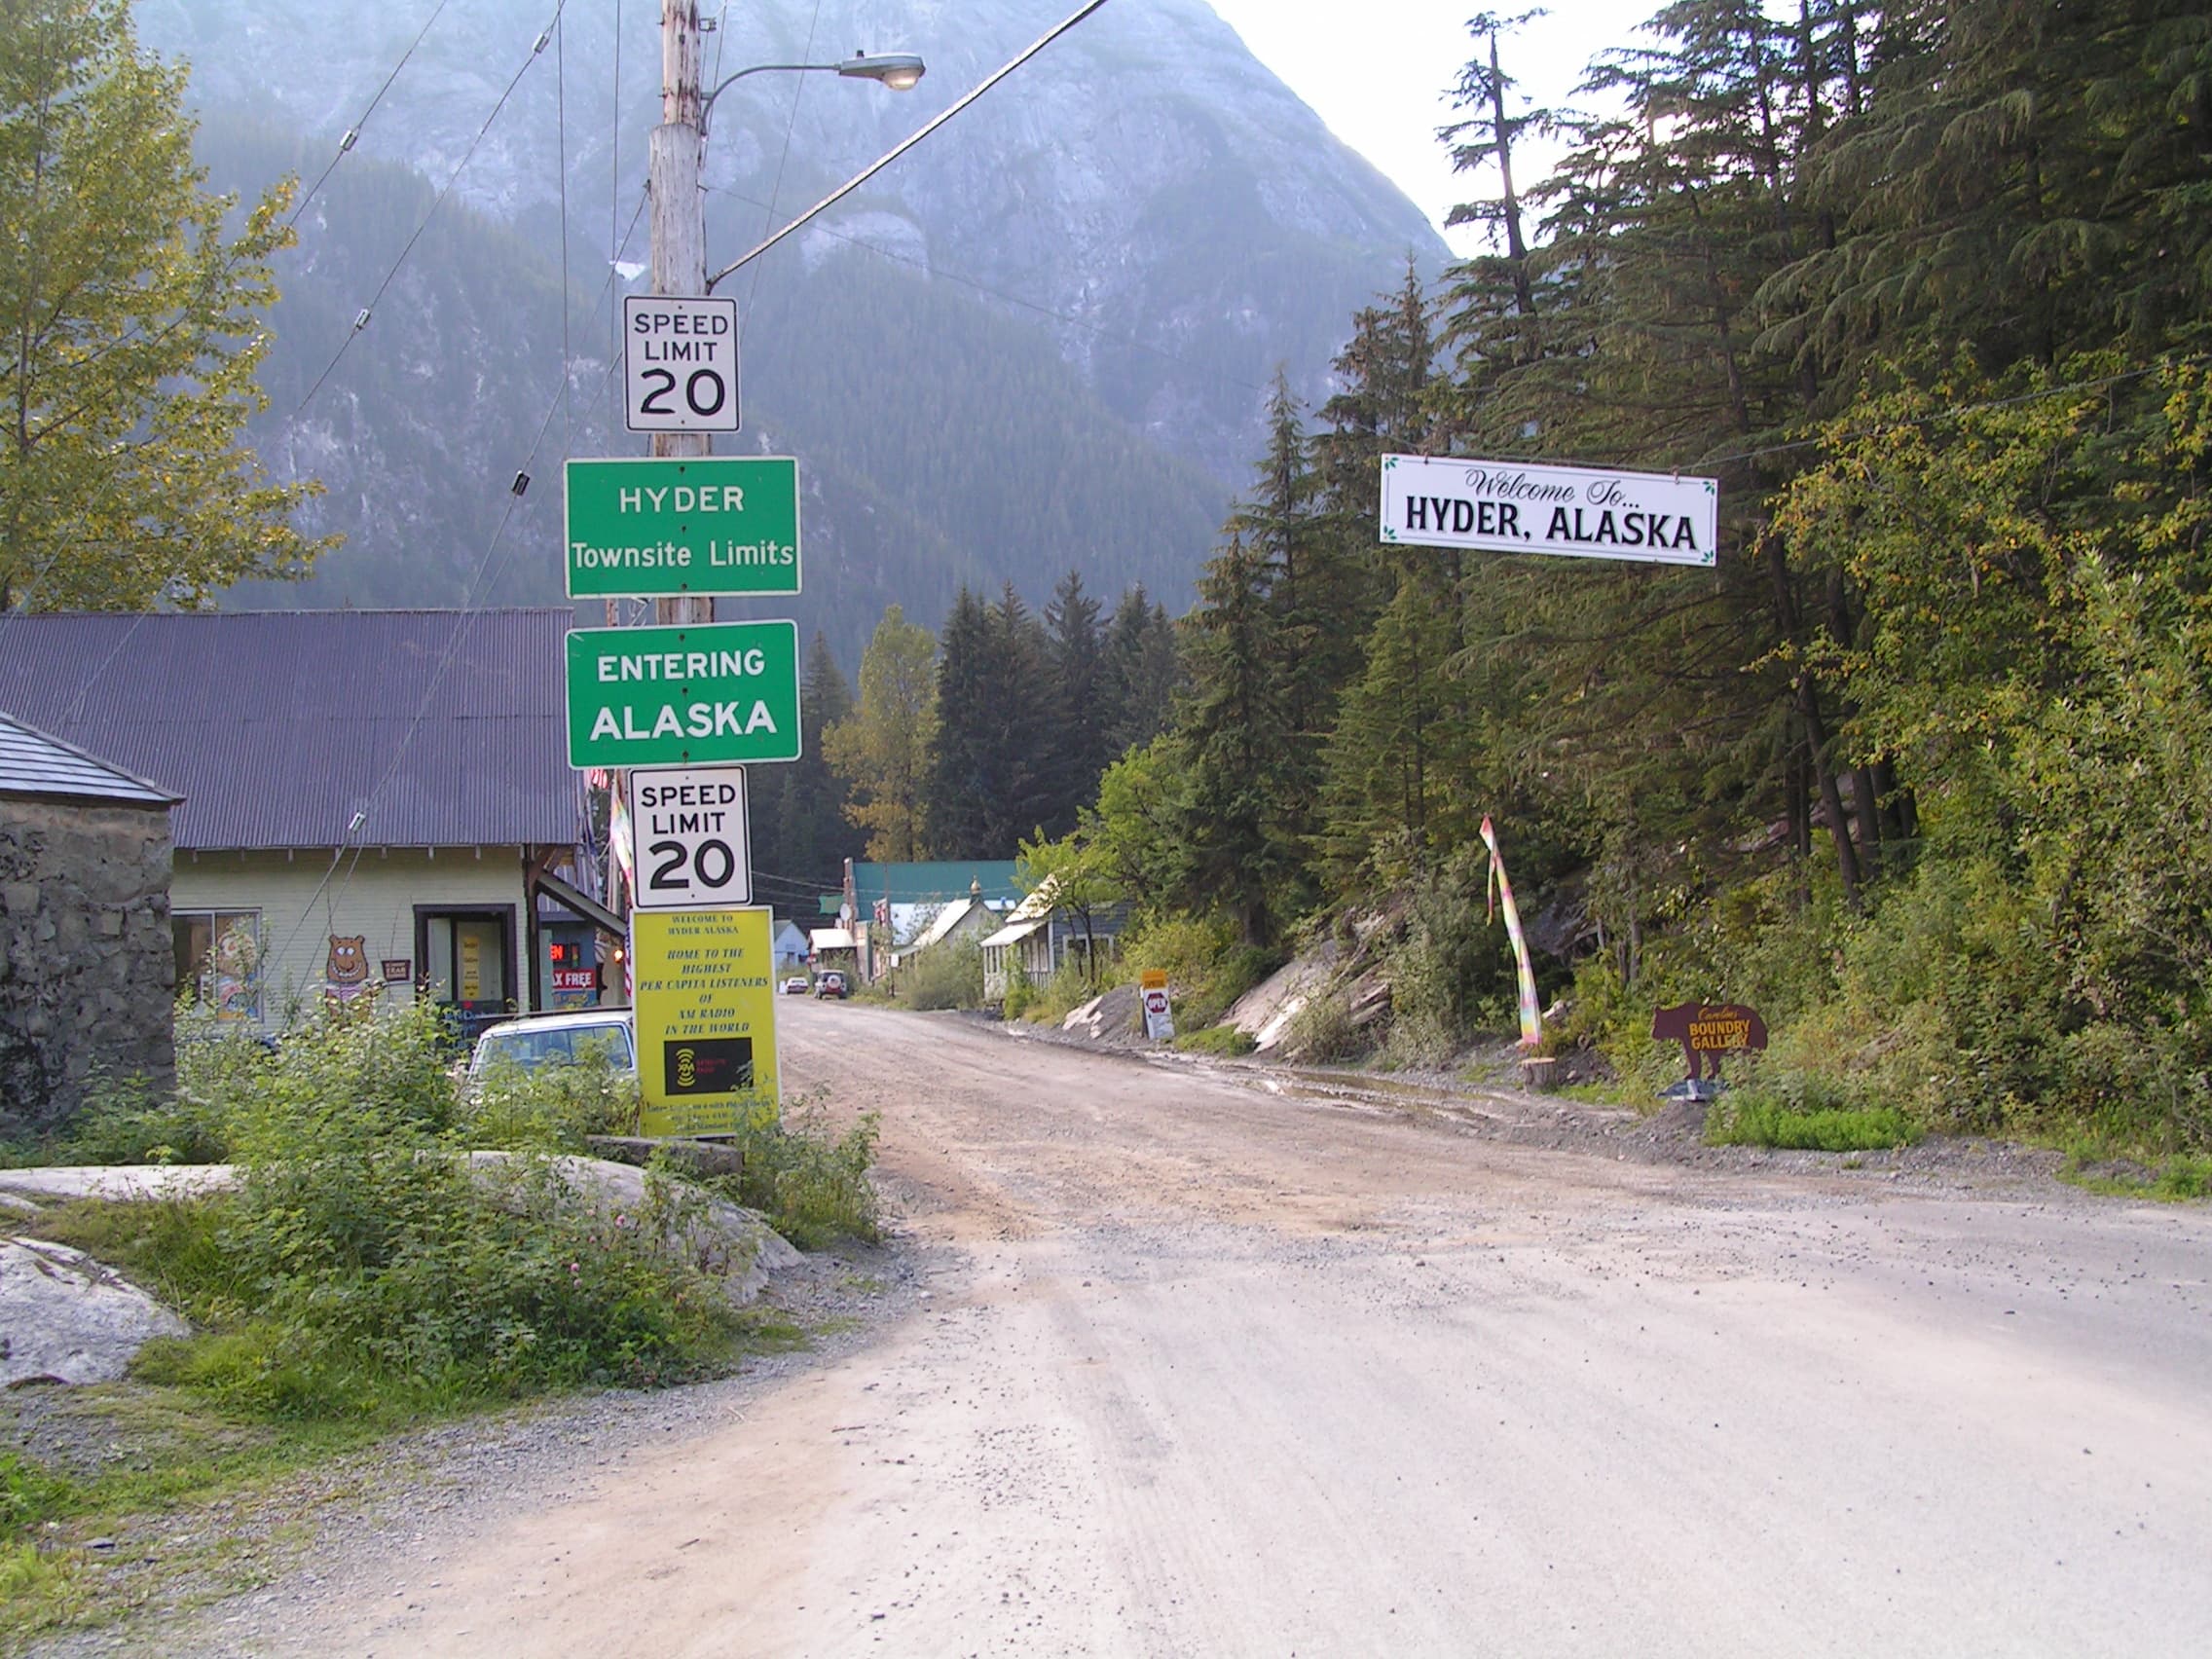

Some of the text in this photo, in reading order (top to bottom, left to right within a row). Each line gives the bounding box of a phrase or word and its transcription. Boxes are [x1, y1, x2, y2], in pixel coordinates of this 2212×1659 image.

[634, 313, 728, 335] SPEED
[645, 341, 718, 361] LIMIT
[641, 368, 725, 416] 20
[1464, 468, 1575, 501] Welcome
[619, 486, 744, 513] HYDER
[1406, 496, 1699, 551] HYDER, ALASKA
[571, 540, 794, 568] Townsite Limits
[598, 648, 765, 682] ENTERING
[589, 700, 777, 741] ALASKA
[642, 784, 736, 807] SPEED
[652, 812, 725, 834] LIMIT
[648, 839, 735, 890] 20
[705, 926, 739, 935] ALASKA
[667, 948, 744, 959] HOME TO THE
[566, 973, 592, 986] FREE
[682, 964, 731, 974] HIGHEST
[640, 977, 768, 990] PER CAPITA LISTENERS
[699, 994, 713, 1004] OF
[680, 1008, 735, 1019] XM RADIO
[665, 1023, 750, 1035] IN THE WORLD
[1689, 1019, 1751, 1037] BOUNDRY
